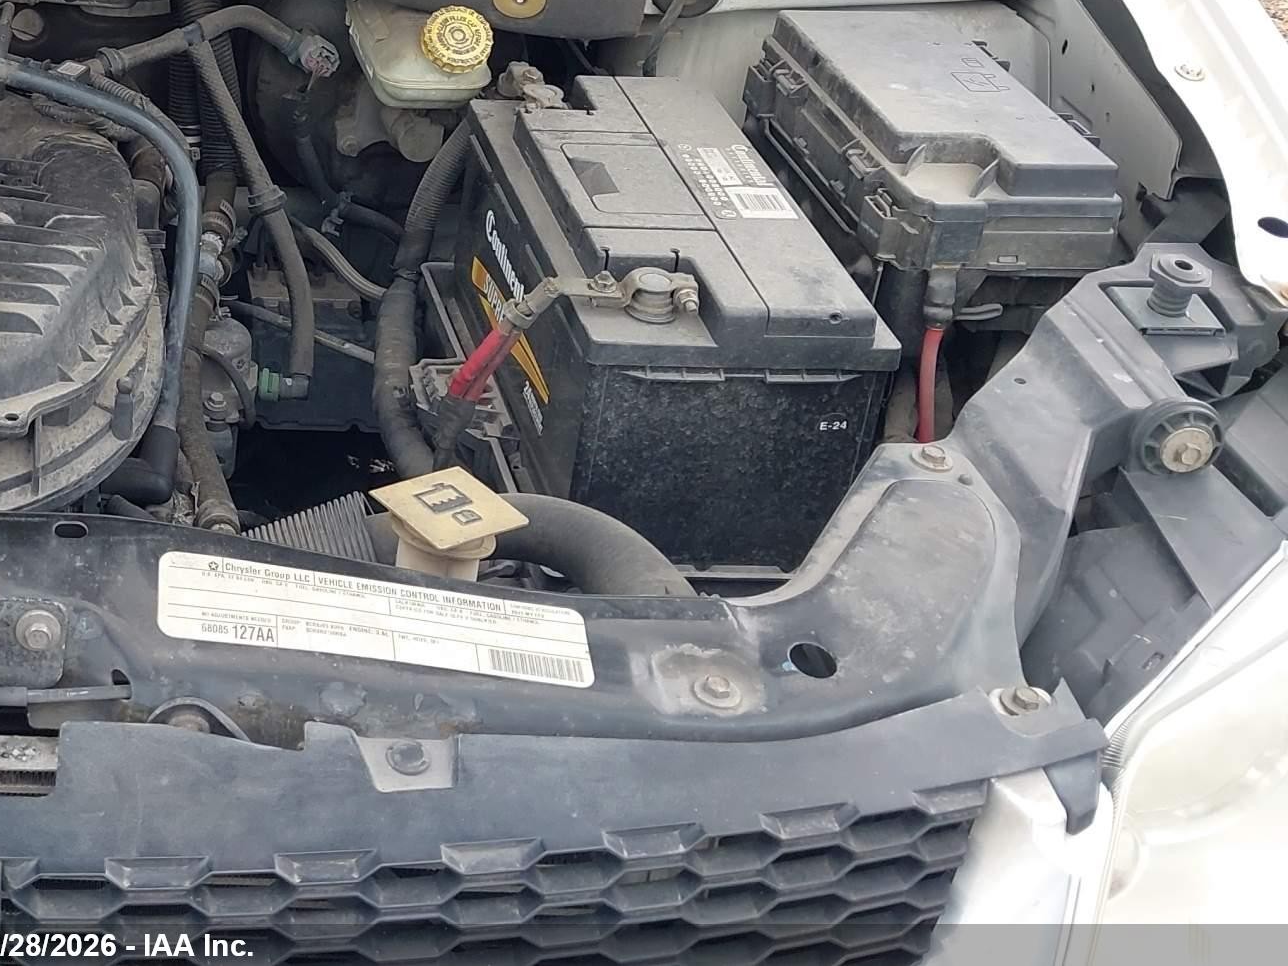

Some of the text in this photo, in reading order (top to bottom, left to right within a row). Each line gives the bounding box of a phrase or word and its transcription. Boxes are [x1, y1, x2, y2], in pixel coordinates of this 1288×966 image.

[486, 210, 524, 303] Continent
[819, 420, 847, 431] E-24
[225, 563, 261, 574] Chrysler
[264, 569, 291, 580] Group
[294, 572, 310, 583] LLC
[318, 577, 352, 589] VEHICLE
[356, 582, 397, 595] EMISSION
[400, 589, 440, 603] CONTROL
[443, 595, 502, 611] INFORMATION
[201, 623, 275, 642] 68085 127AA
